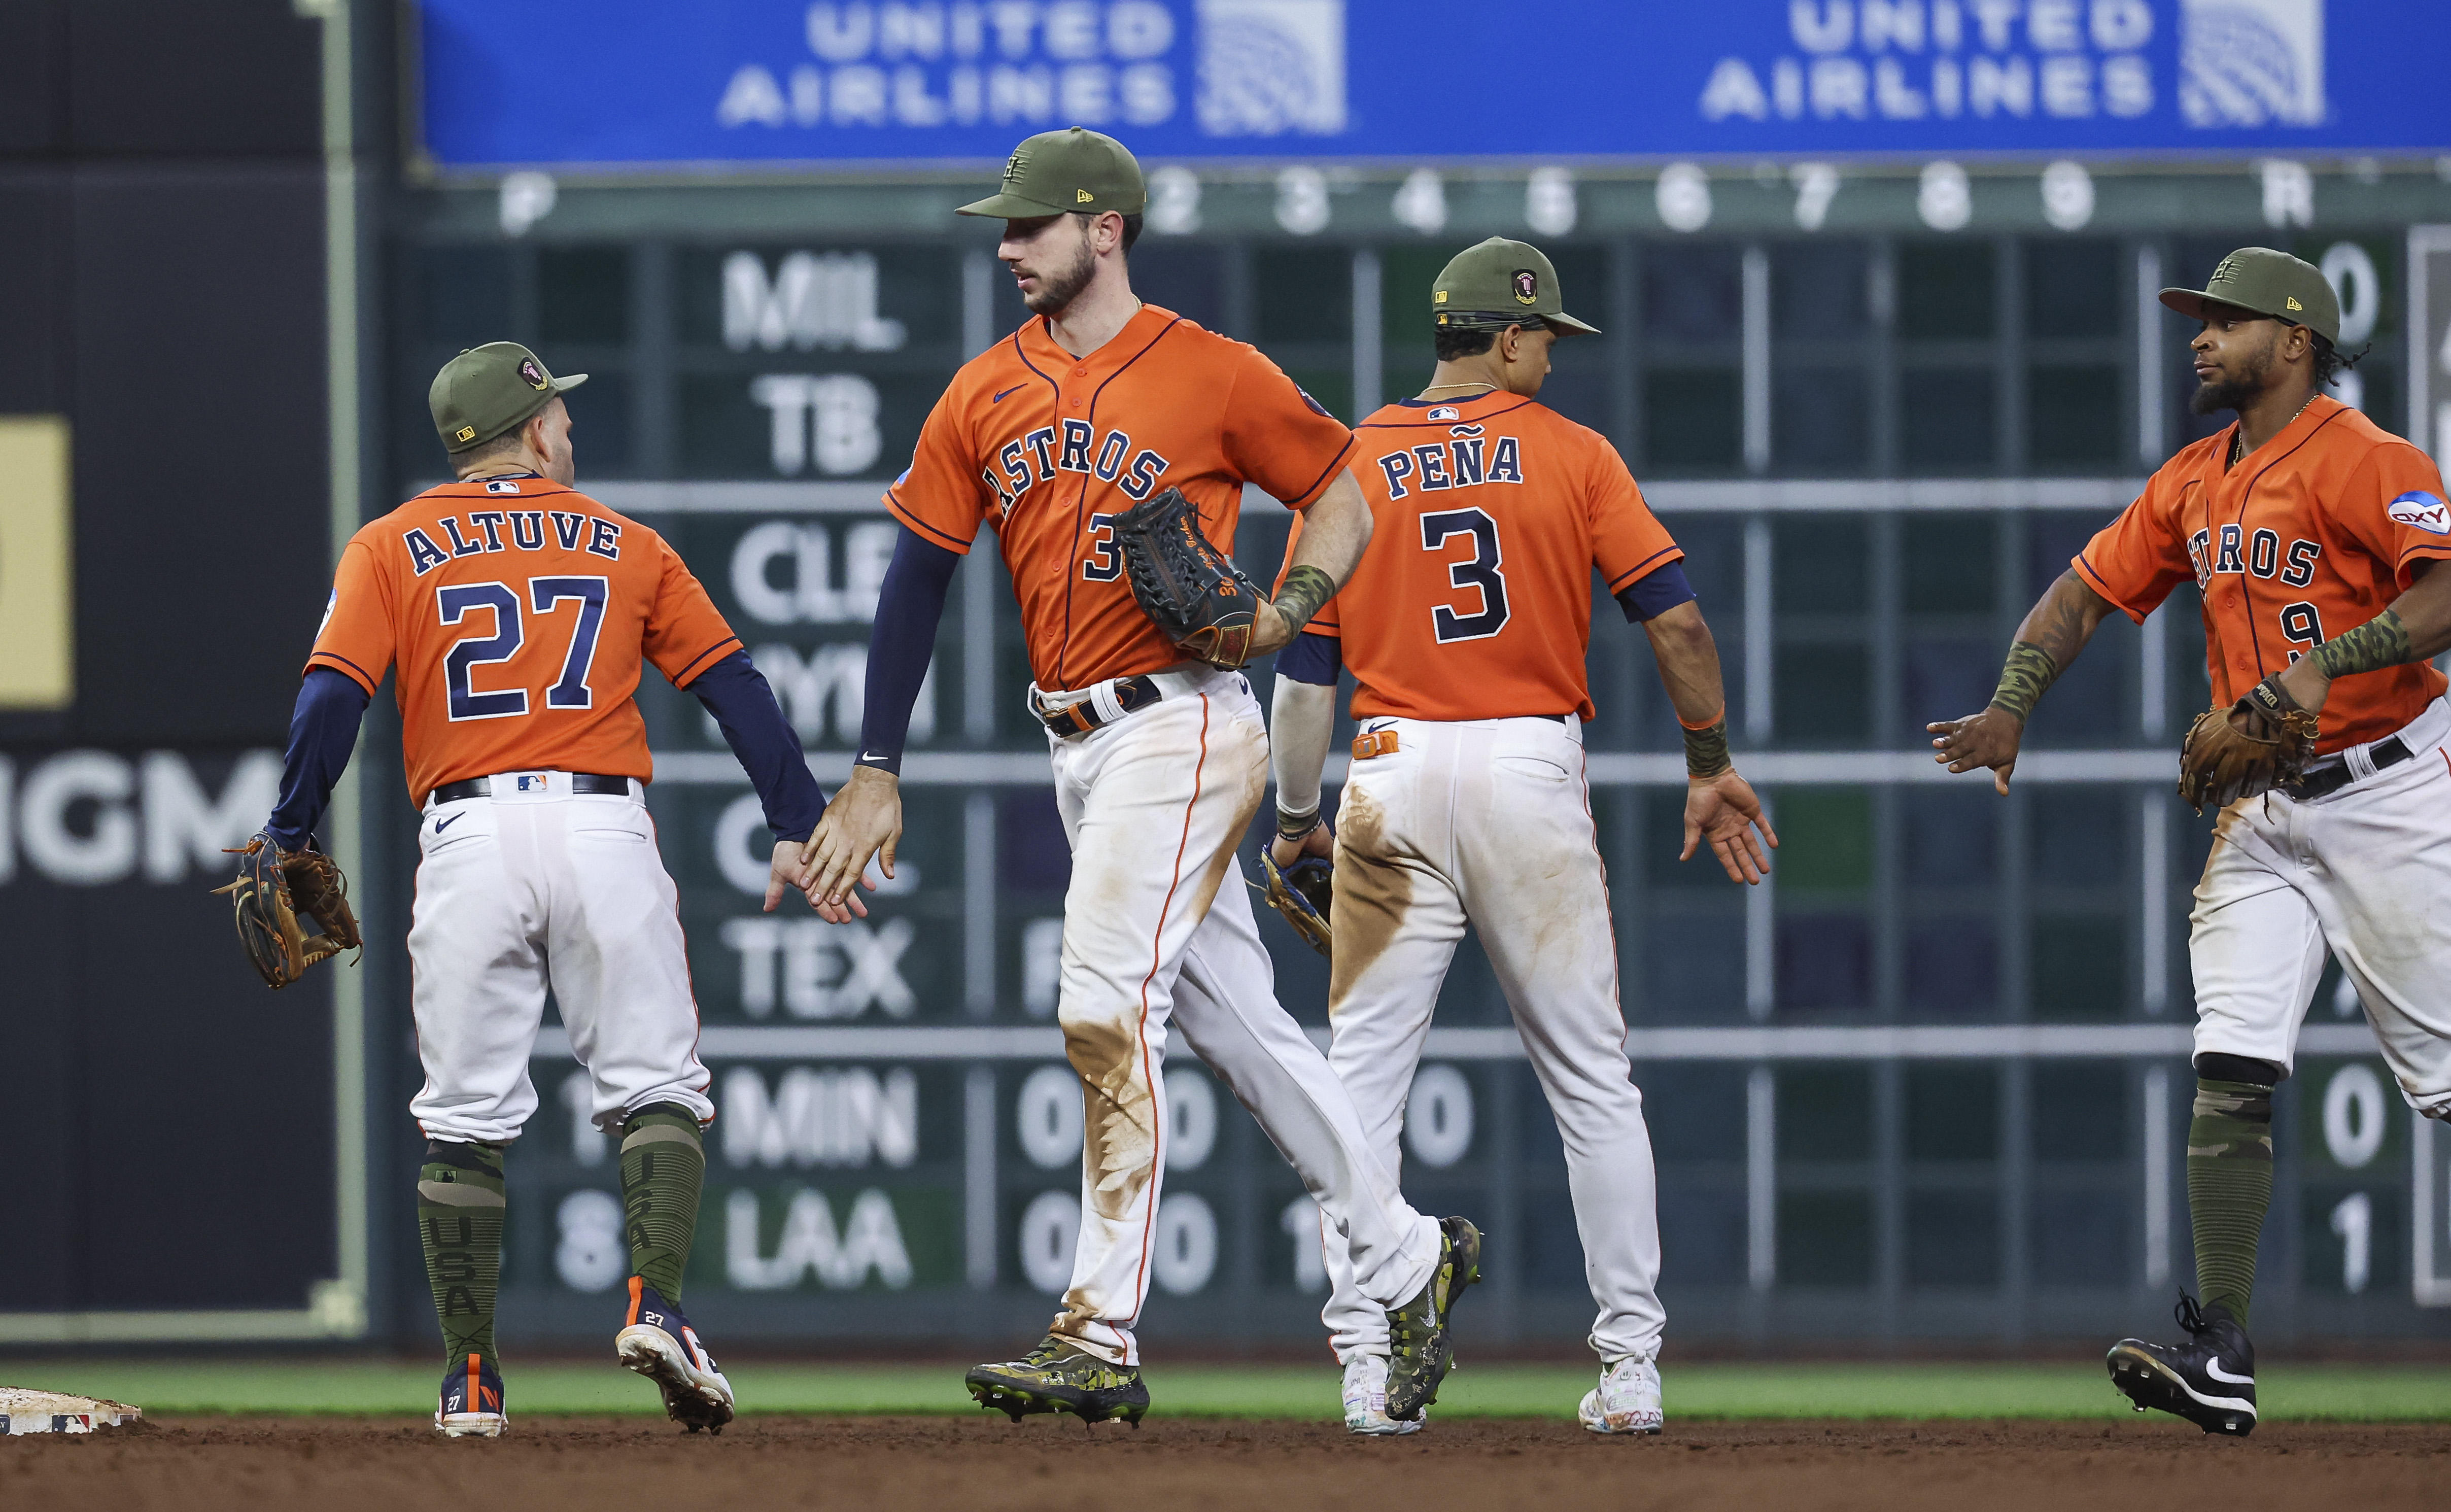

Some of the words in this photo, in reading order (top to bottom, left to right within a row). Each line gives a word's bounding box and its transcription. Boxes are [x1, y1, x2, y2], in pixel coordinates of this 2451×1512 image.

[808, 0, 1176, 62] UNITED
[1788, 0, 2154, 53] UNITED
[718, 65, 1176, 128] AIRLINES
[1701, 57, 2154, 121] AIRLINES
[500, 171, 557, 236] P
[1274, 165, 1330, 235] 3
[1392, 167, 1447, 235] 4
[1790, 161, 1843, 232] 7
[721, 250, 907, 352] MIL
[751, 372, 882, 475] TB
[1376, 423, 1524, 501] PEÑA
[982, 417, 1170, 521] ASTROS
[402, 510, 622, 577] ALTUVE
[2392, 507, 2445, 524] OXY
[731, 522, 895, 624] CLE
[1219, 576, 1238, 597] 30
[1420, 506, 1511, 644] 3
[2187, 523, 2322, 605] STROS
[436, 574, 609, 723] 27
[2279, 601, 2325, 666] 9
[720, 919, 915, 1017] TEX
[721, 1067, 917, 1168] MIN
[1018, 1066, 1085, 1169] 0
[1165, 1066, 1217, 1171] 0
[1407, 1064, 1474, 1168] 0
[2323, 1066, 2387, 1168] 0
[428, 1217, 479, 1317] USA
[726, 1187, 911, 1291] LAA
[1019, 1190, 1085, 1295] 0
[1151, 1190, 1217, 1295] 0
[2330, 1191, 2370, 1294] 1
[645, 1311, 664, 1327] 27
[447, 1395, 461, 1412] 27
